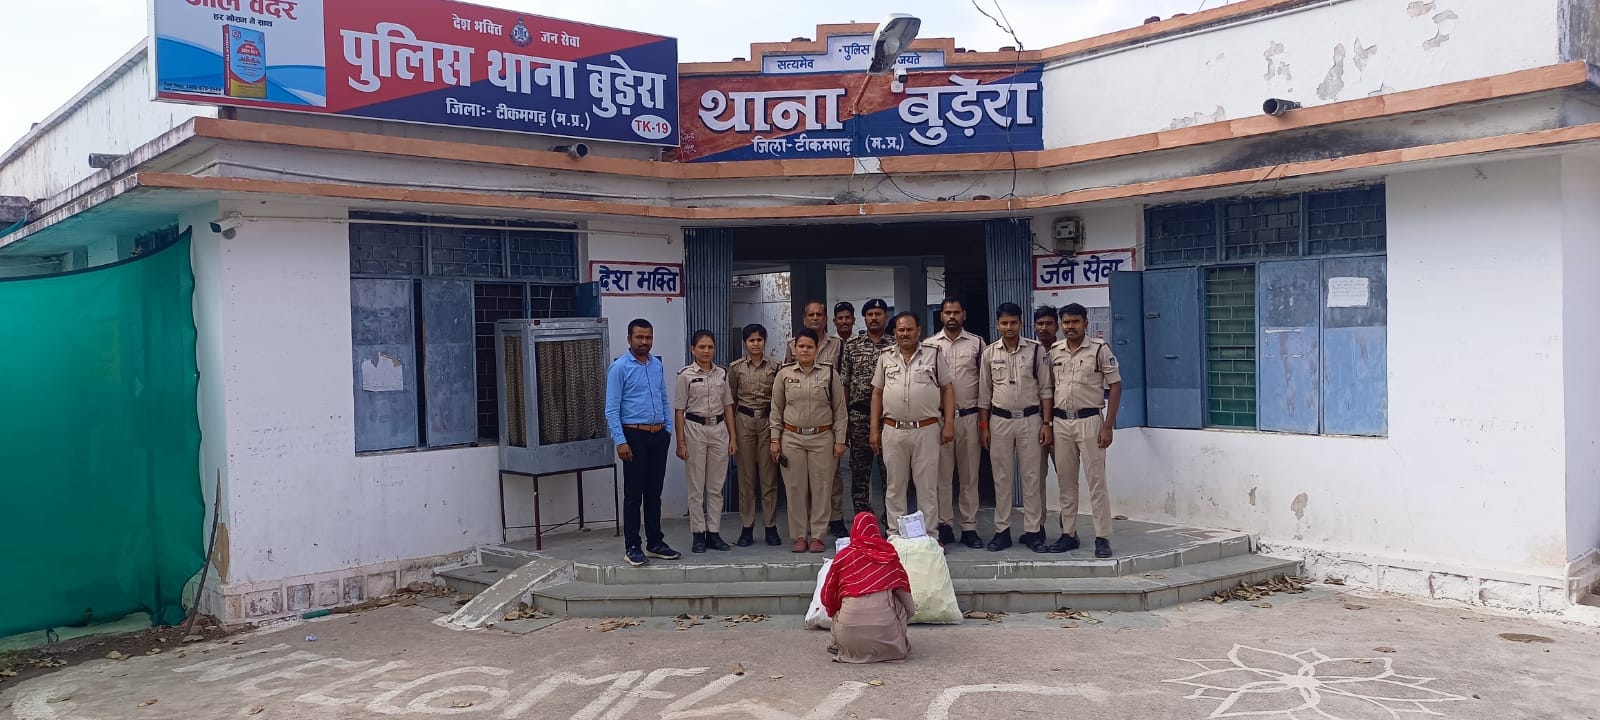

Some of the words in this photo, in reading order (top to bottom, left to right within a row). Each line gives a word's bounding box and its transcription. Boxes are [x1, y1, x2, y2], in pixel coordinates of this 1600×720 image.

[452, 14, 471, 31] देश
[474, 18, 502, 36] भक्ति
[540, 31, 558, 45] जन
[561, 31, 580, 48] सेवा
[339, 21, 475, 93] पुलिस
[487, 49, 578, 100] थाना
[586, 54, 667, 118] बुड़ेरा
[777, 56, 814, 71] सत्यमेव
[898, 52, 922, 66] जयते
[496, 103, 547, 126] टीकमगढ़
[698, 88, 847, 132] थाना
[898, 74, 1038, 146] बुड़ेरा
[634, 120, 668, 134] TK-19
[599, 265, 633, 292] देश
[636, 266, 679, 292] भक्ति
